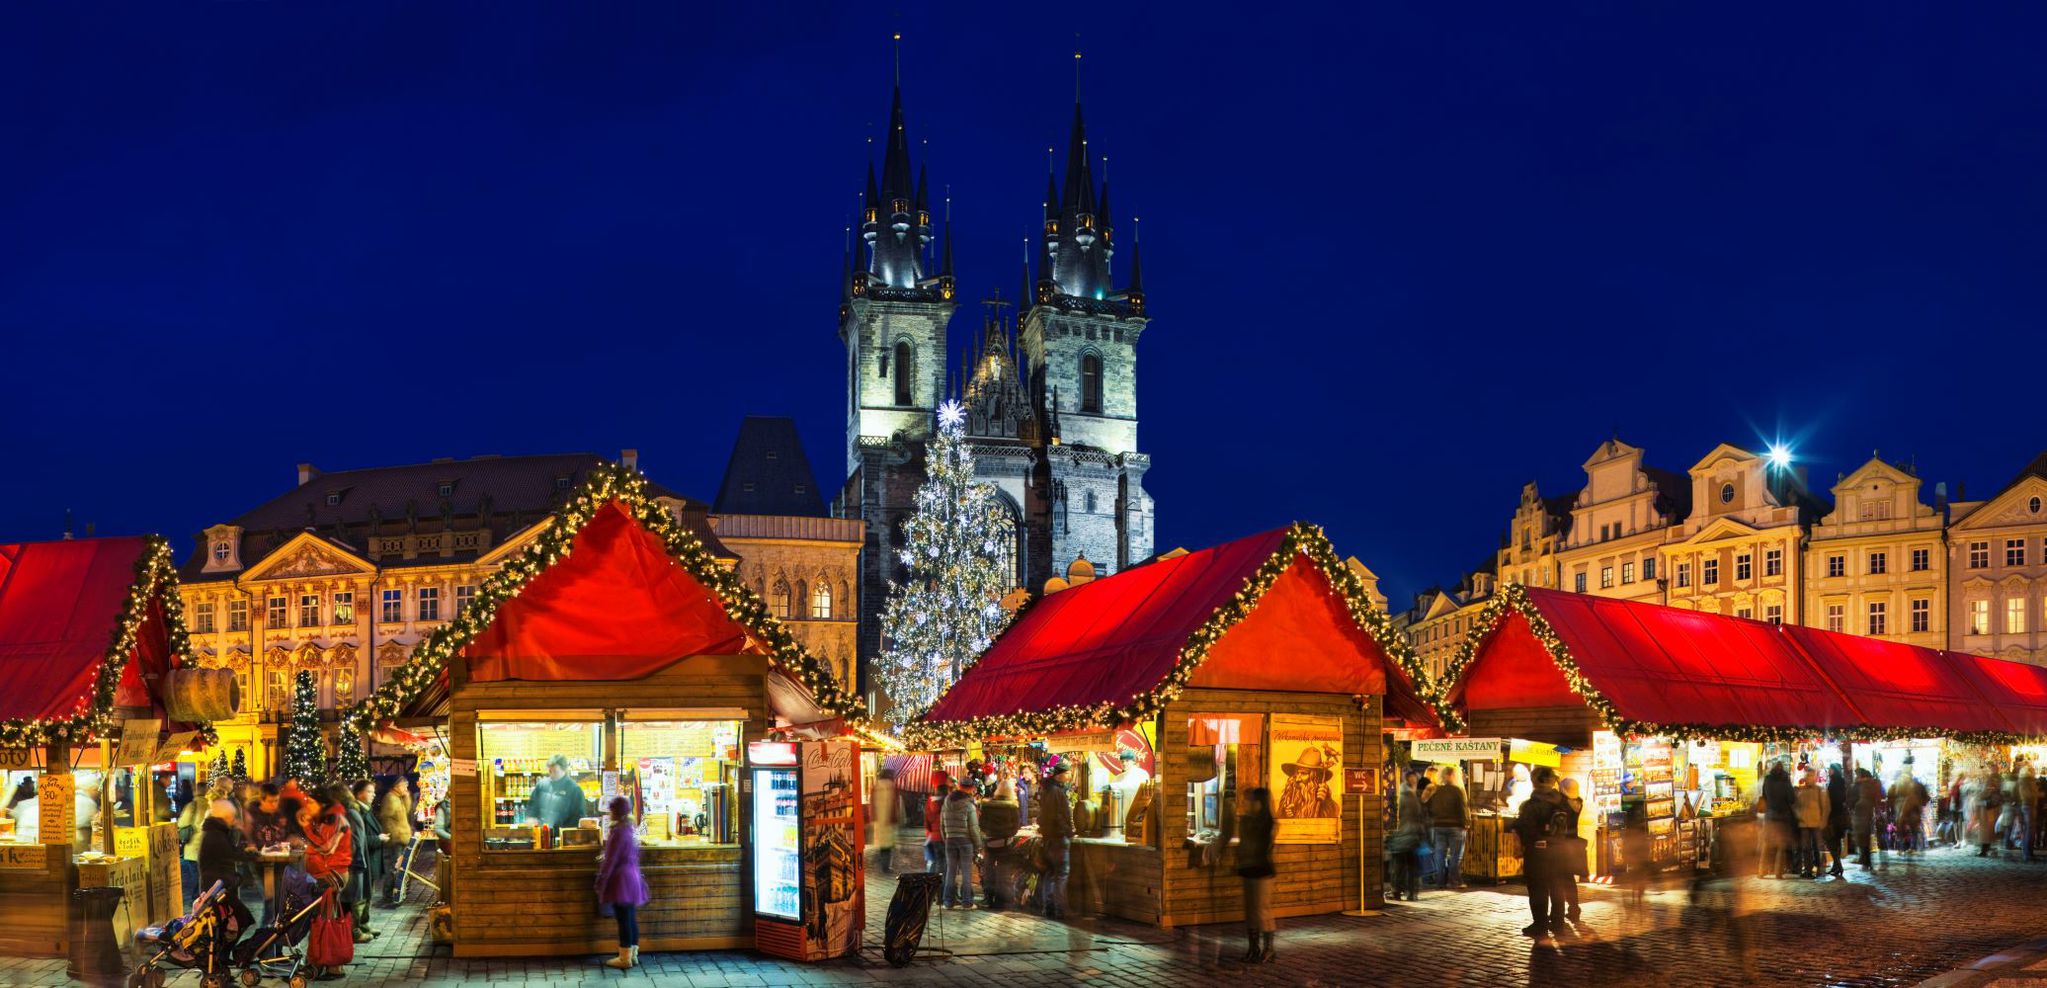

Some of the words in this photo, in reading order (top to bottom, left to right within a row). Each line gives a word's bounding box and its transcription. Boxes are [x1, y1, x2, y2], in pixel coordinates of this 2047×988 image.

[1418, 741, 1452, 752] PEČENÉ
[1455, 741, 1498, 751] KAŠTANY
[807, 748, 852, 770] Coa-Col
[1353, 771, 1367, 780] WC
